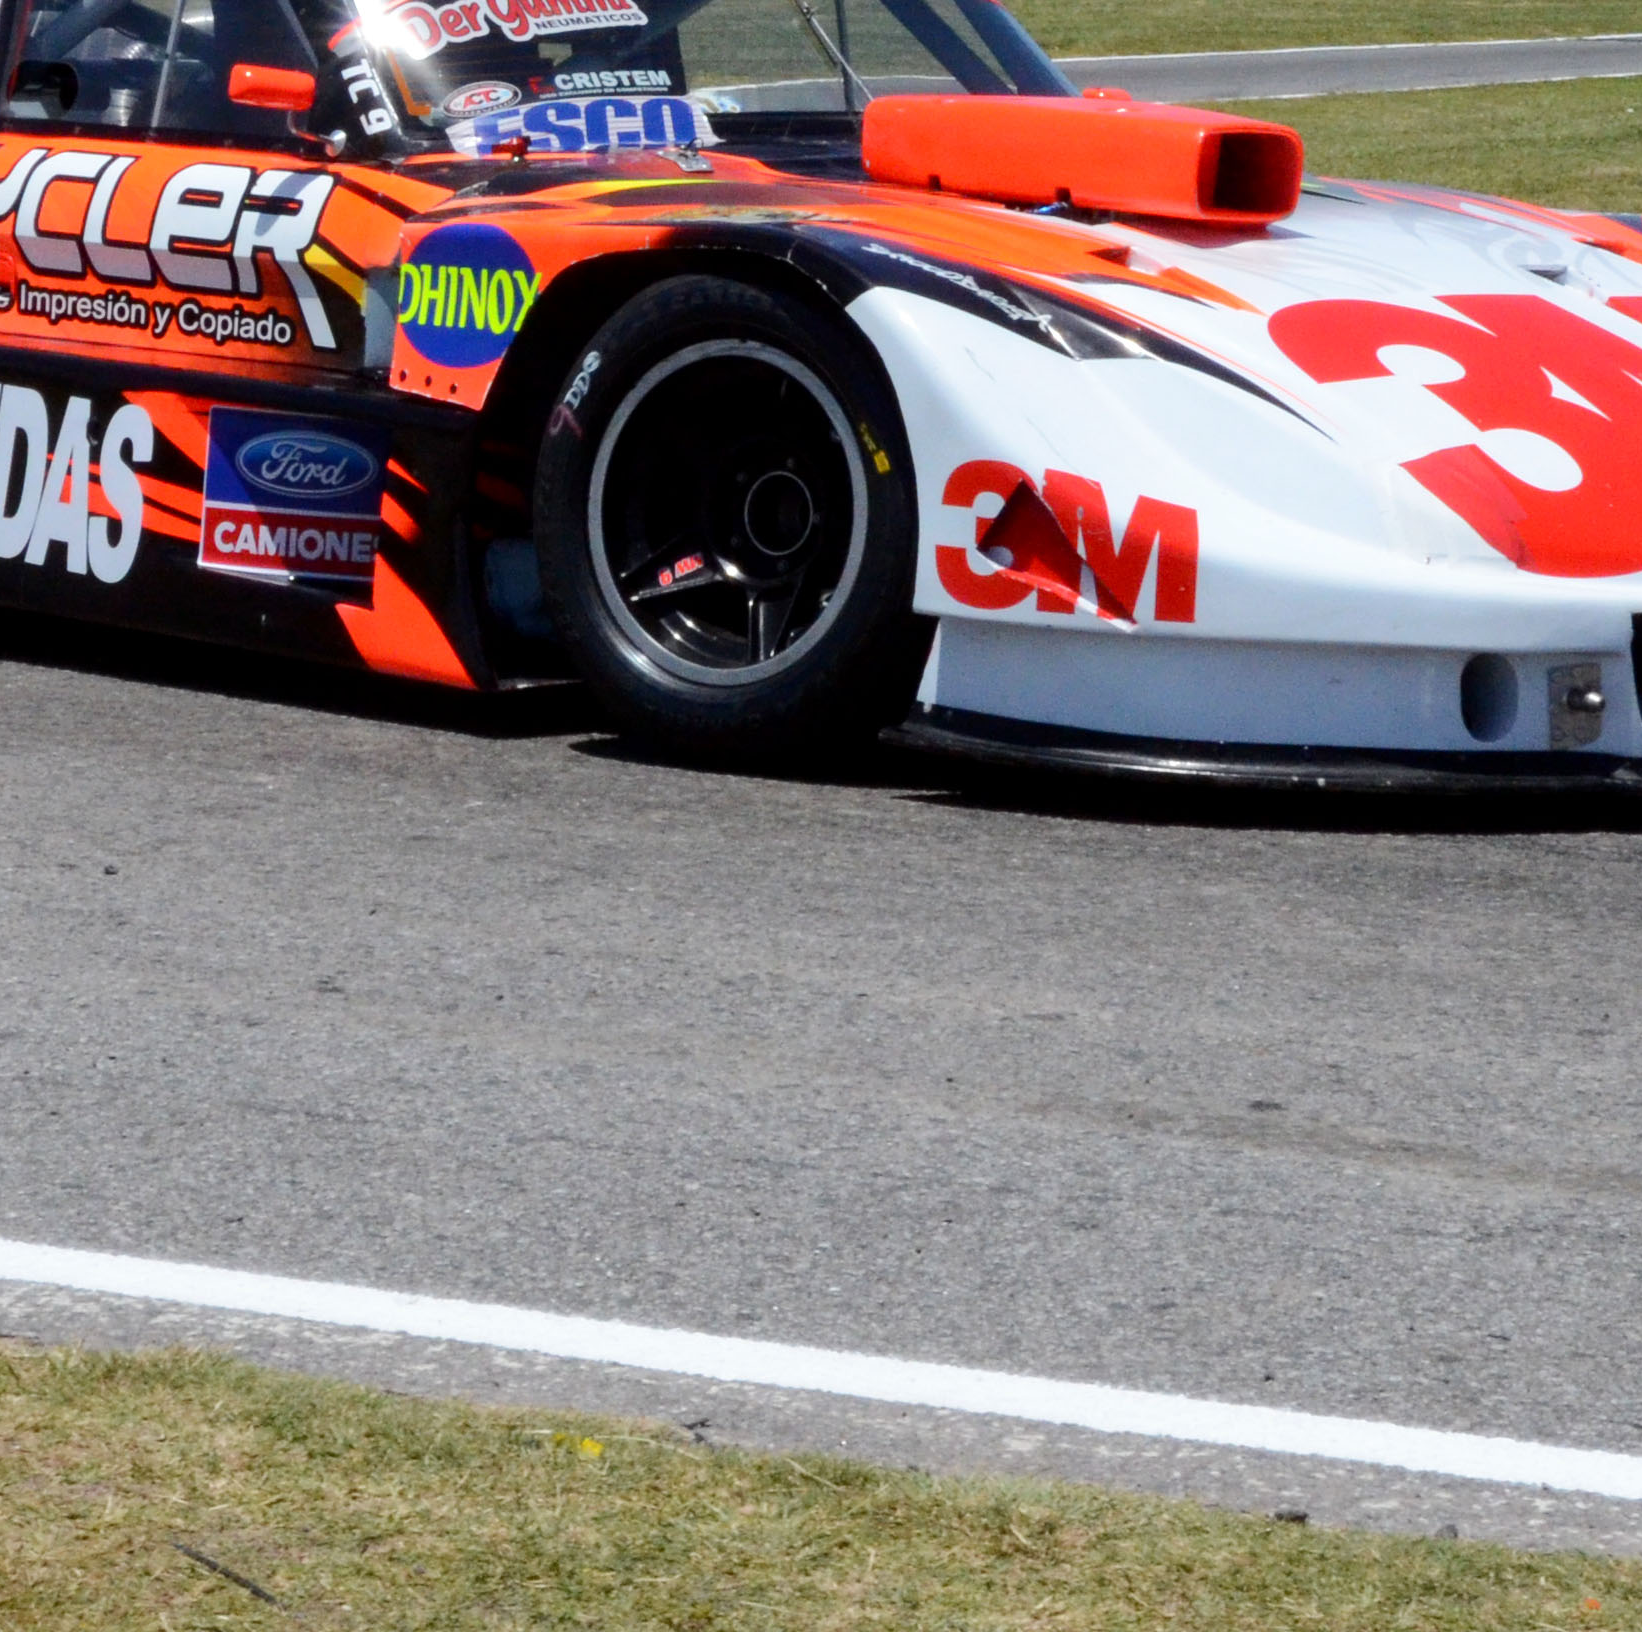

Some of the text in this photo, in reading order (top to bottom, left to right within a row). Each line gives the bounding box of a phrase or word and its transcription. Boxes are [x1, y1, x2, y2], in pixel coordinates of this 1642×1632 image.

[401, 1, 481, 51] Der
[534, 12, 643, 31] NEUMATICOS
[554, 70, 672, 91] CRISTEM
[19, 284, 146, 326] Impresión
[153, 305, 171, 334] y
[177, 303, 293, 344] Copiado
[261, 440, 349, 485] Ford
[213, 520, 380, 564] CAMIONE
[935, 459, 1200, 628] 3M
